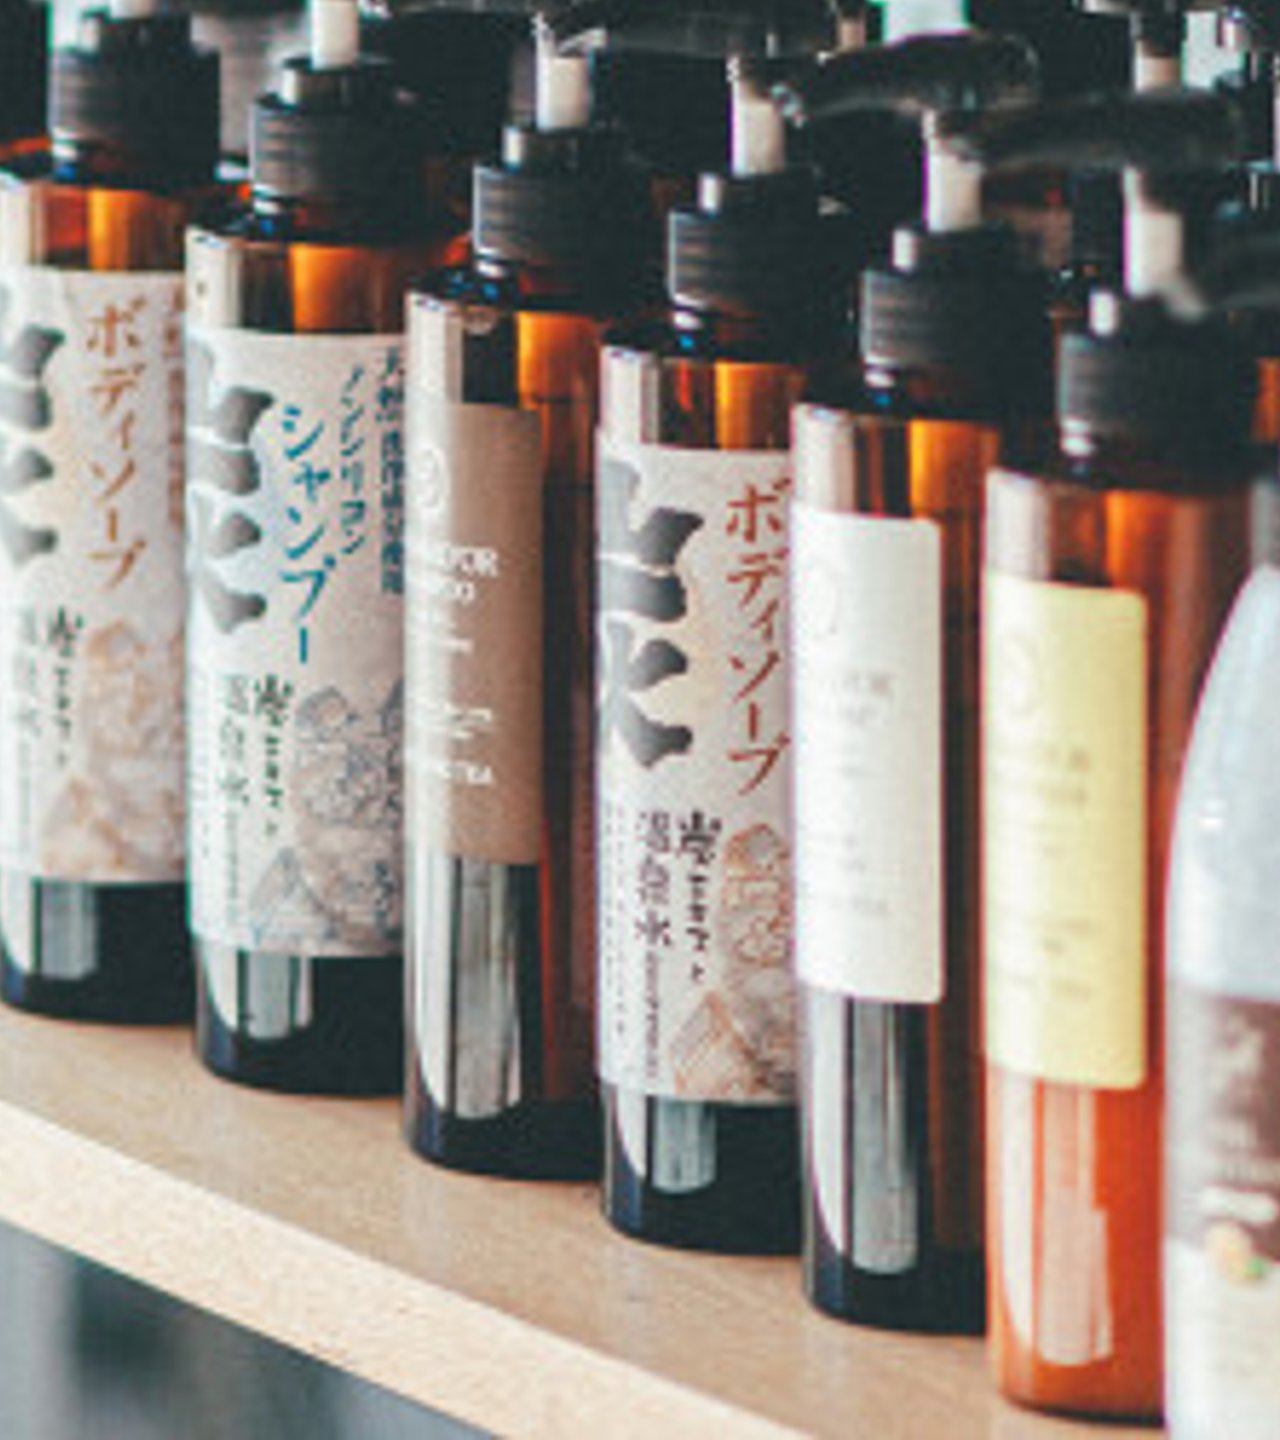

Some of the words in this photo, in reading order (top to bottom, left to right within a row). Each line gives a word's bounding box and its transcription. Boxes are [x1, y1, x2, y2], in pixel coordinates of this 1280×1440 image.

[85, 295, 148, 592] ボディソープ
[278, 404, 337, 664] シャンプー
[339, 364, 367, 554] ノンシリコン
[724, 476, 792, 797] ボディソープ
